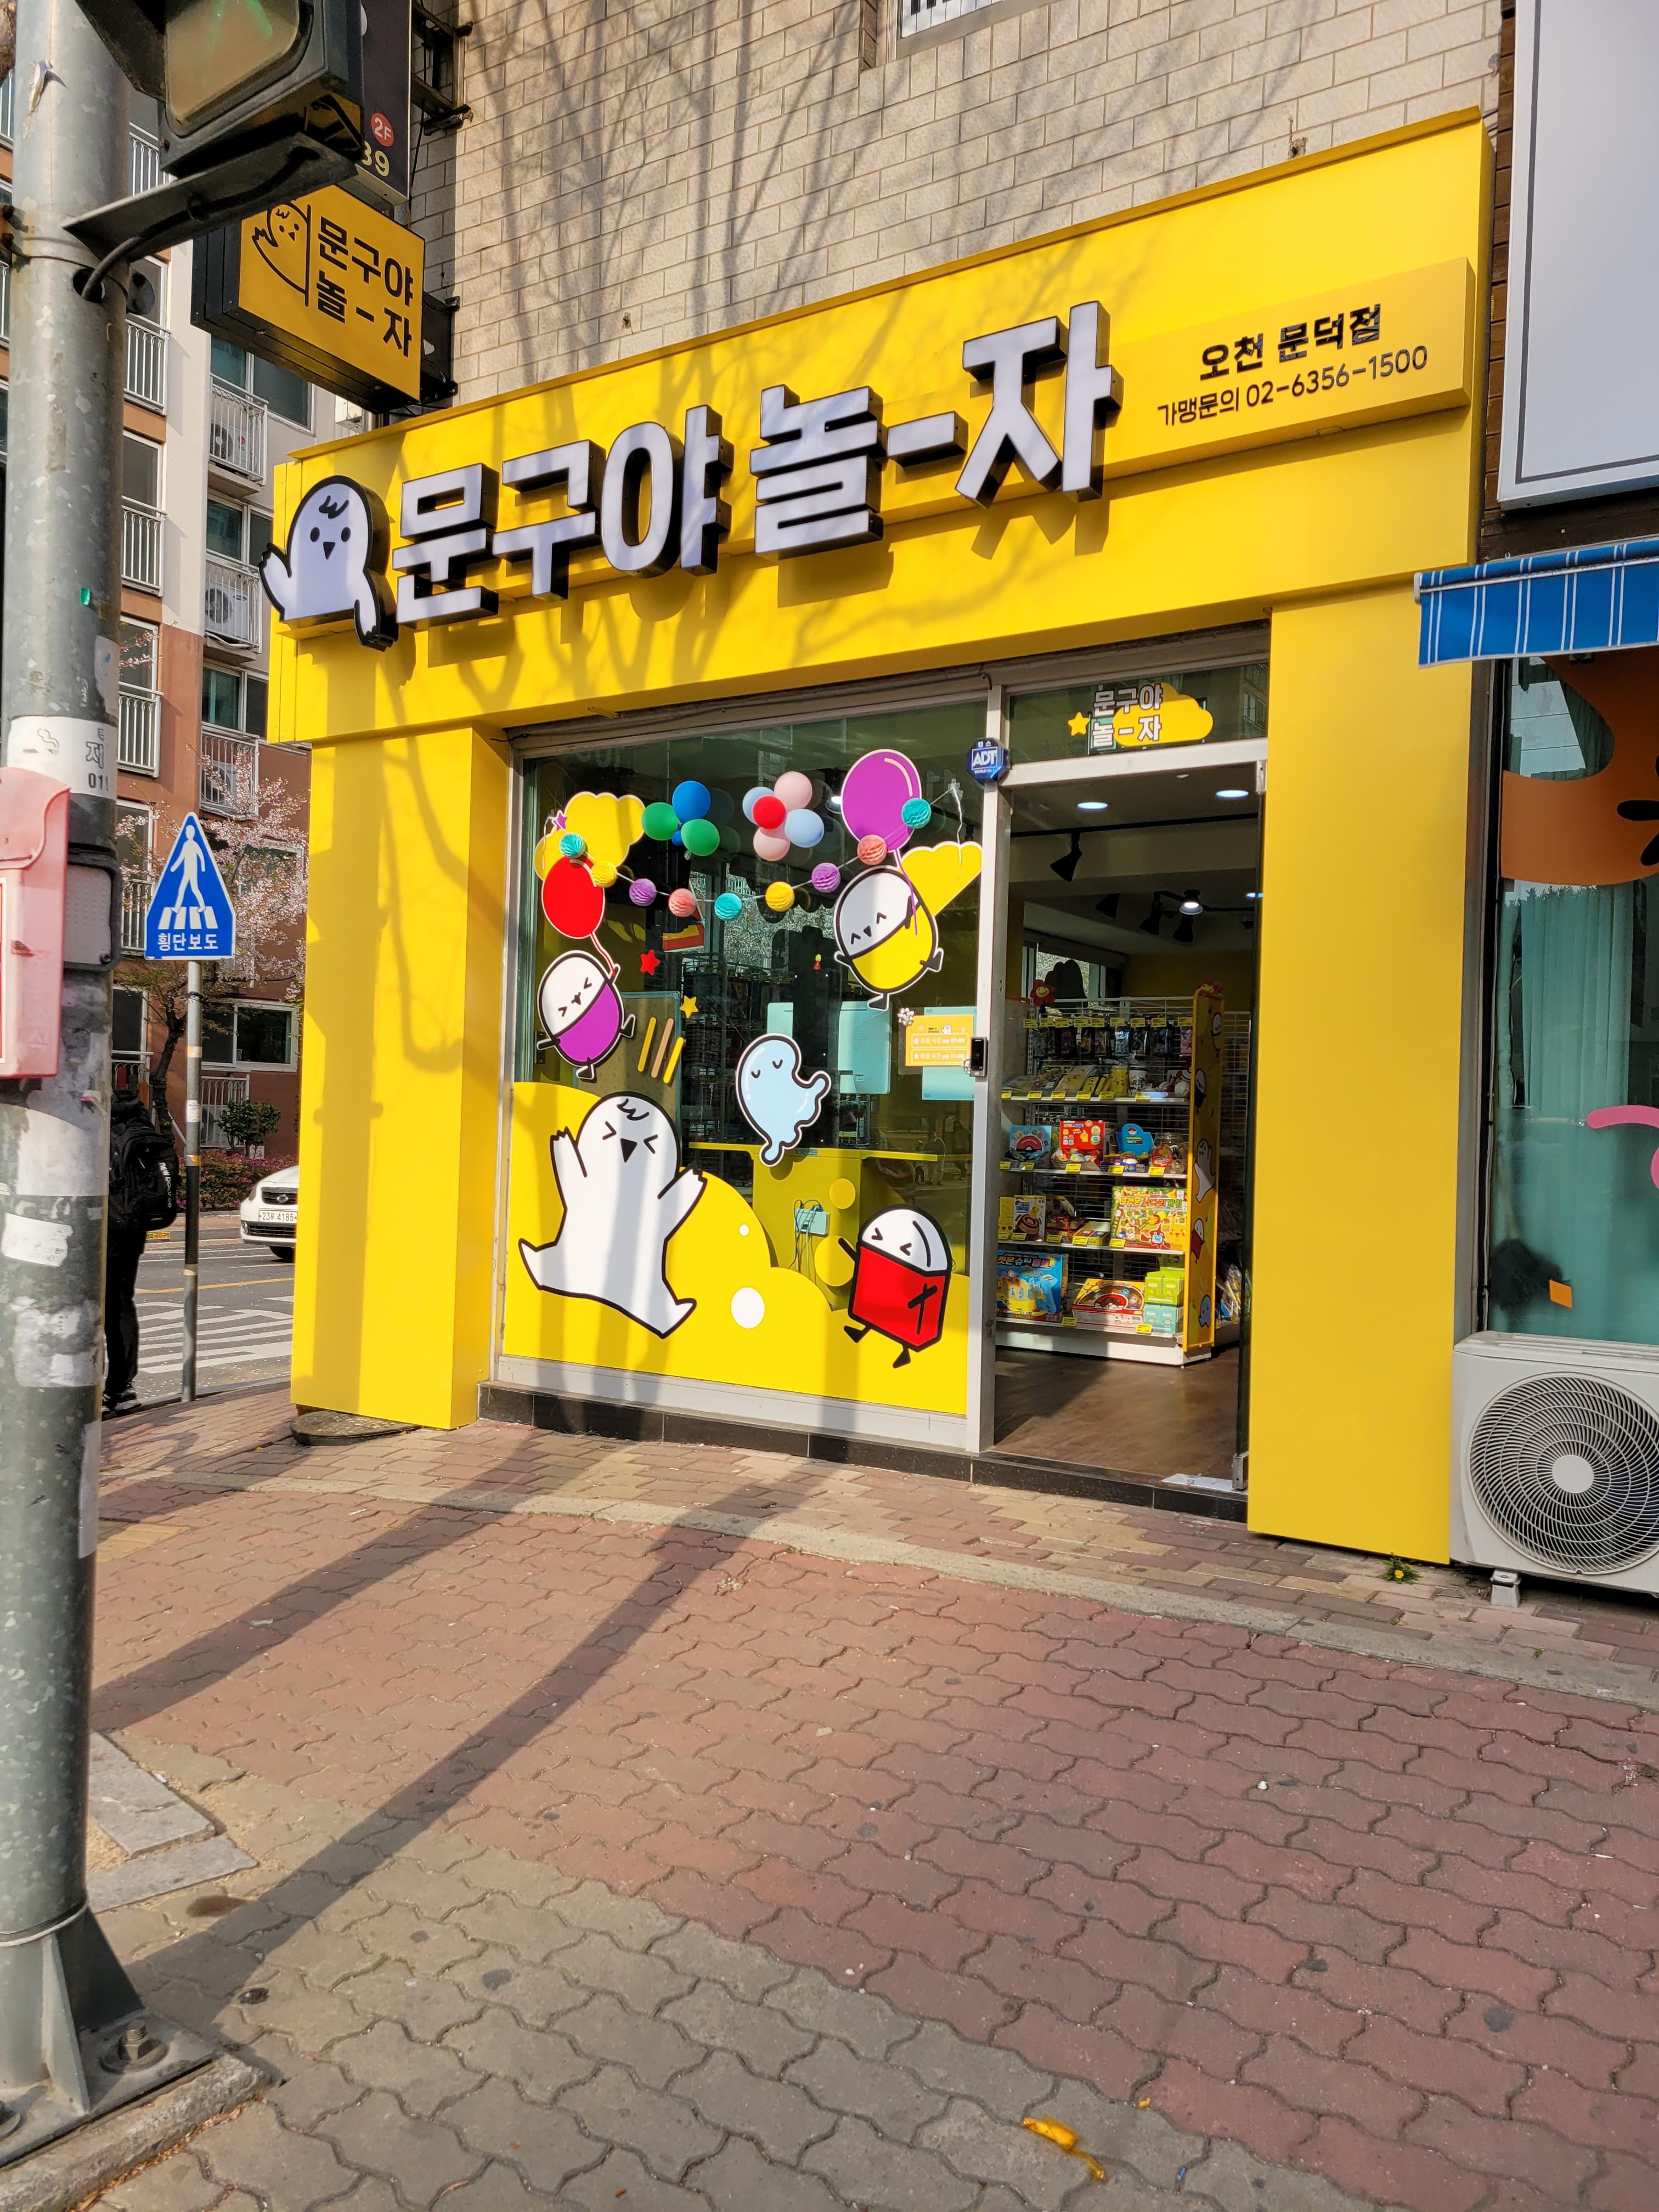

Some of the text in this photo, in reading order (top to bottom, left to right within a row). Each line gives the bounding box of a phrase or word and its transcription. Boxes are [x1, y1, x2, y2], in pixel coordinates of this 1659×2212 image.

[375, 117, 391, 141] 2F
[318, 216, 414, 307] 문구야
[317, 269, 412, 358] 놀-자
[1200, 303, 1381, 380] 오천 문덕점
[1158, 345, 1427, 426] 가맹문의 02-6356-1500
[392, 301, 1122, 627] 문구야 놀-자
[1093, 684, 1163, 717] 문구야
[973, 749, 997, 767] ADT
[1092, 715, 1162, 748] 놀-자
[158, 933, 219, 951] 횡단보도
